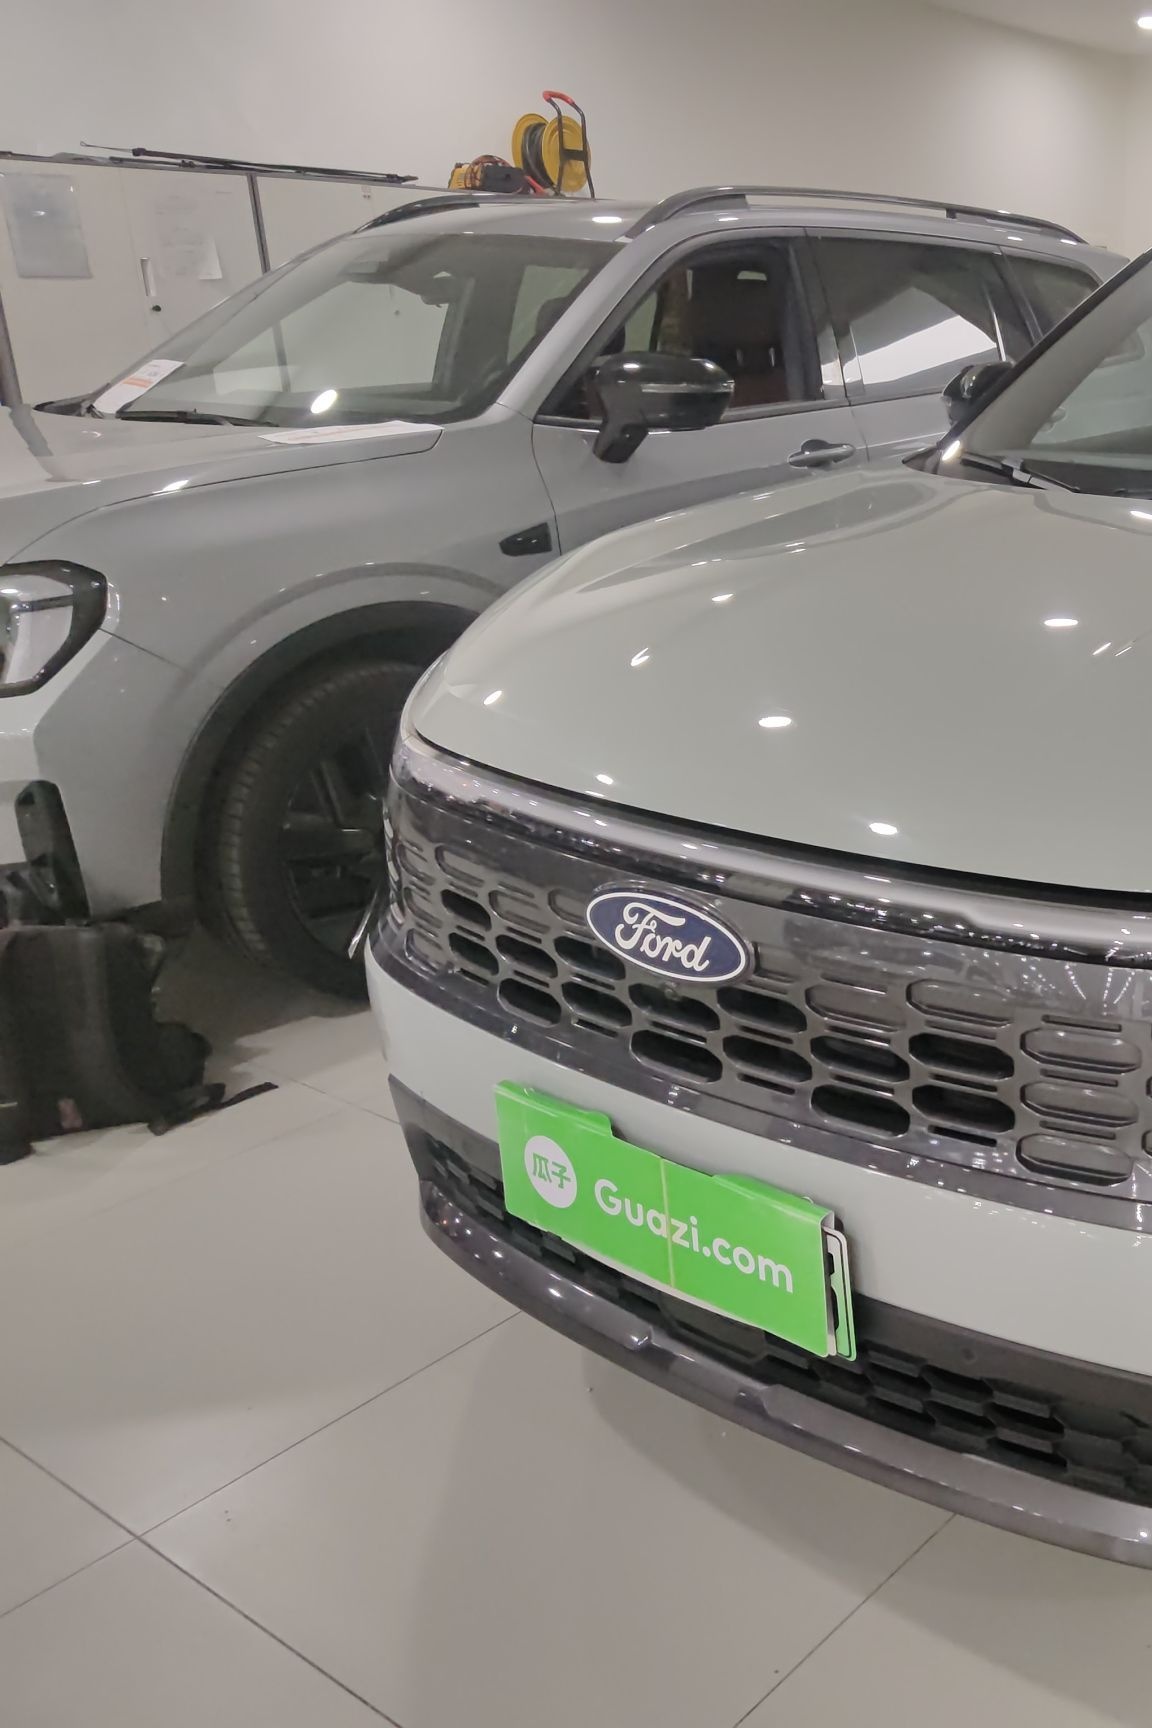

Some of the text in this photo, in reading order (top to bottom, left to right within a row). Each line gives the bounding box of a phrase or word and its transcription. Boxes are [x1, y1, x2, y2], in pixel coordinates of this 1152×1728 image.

[614, 902, 712, 972] Ford
[532, 1152, 571, 1189] 瓜子
[594, 1179, 794, 1293] Guazi.com
